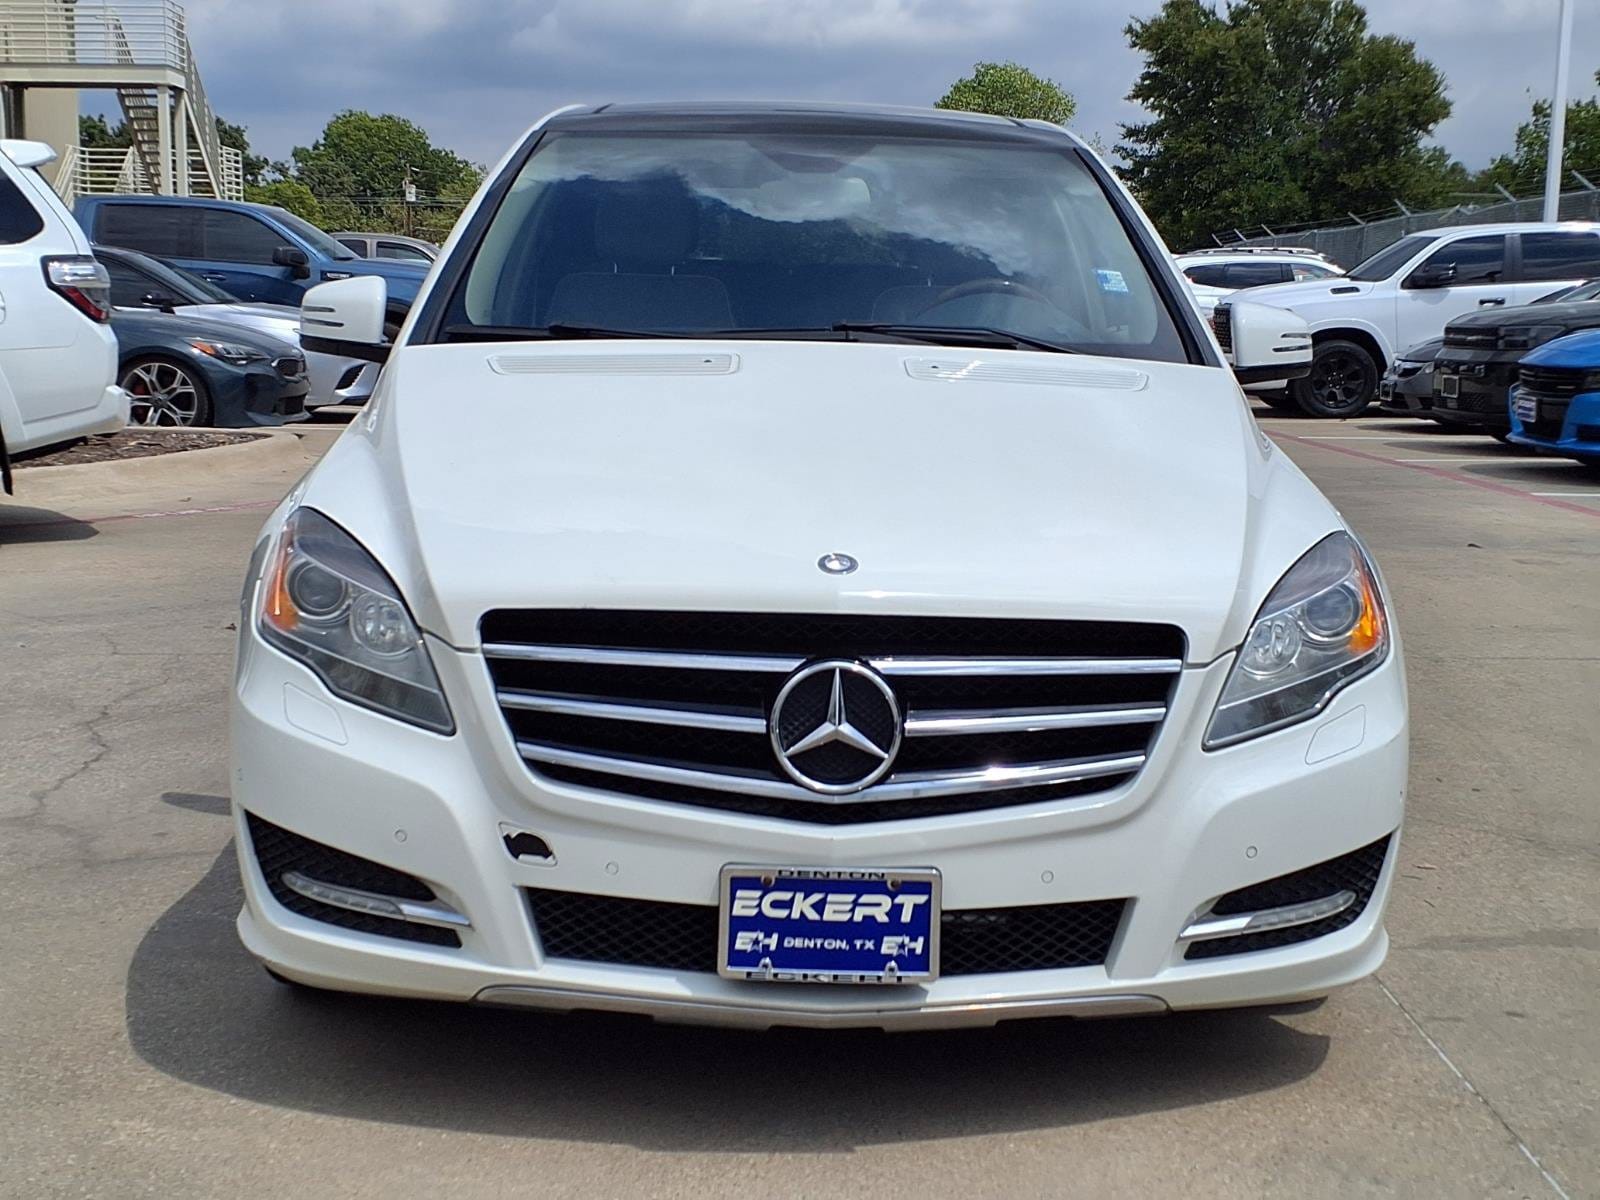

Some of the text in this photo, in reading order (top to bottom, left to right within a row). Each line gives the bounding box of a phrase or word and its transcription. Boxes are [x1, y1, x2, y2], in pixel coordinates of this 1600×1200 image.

[778, 869, 885, 880] DENTON
[731, 889, 929, 923] ECKERT
[783, 936, 850, 951] DENTON,
[853, 939, 876, 951] TX
[746, 971, 912, 984] ECKERT
